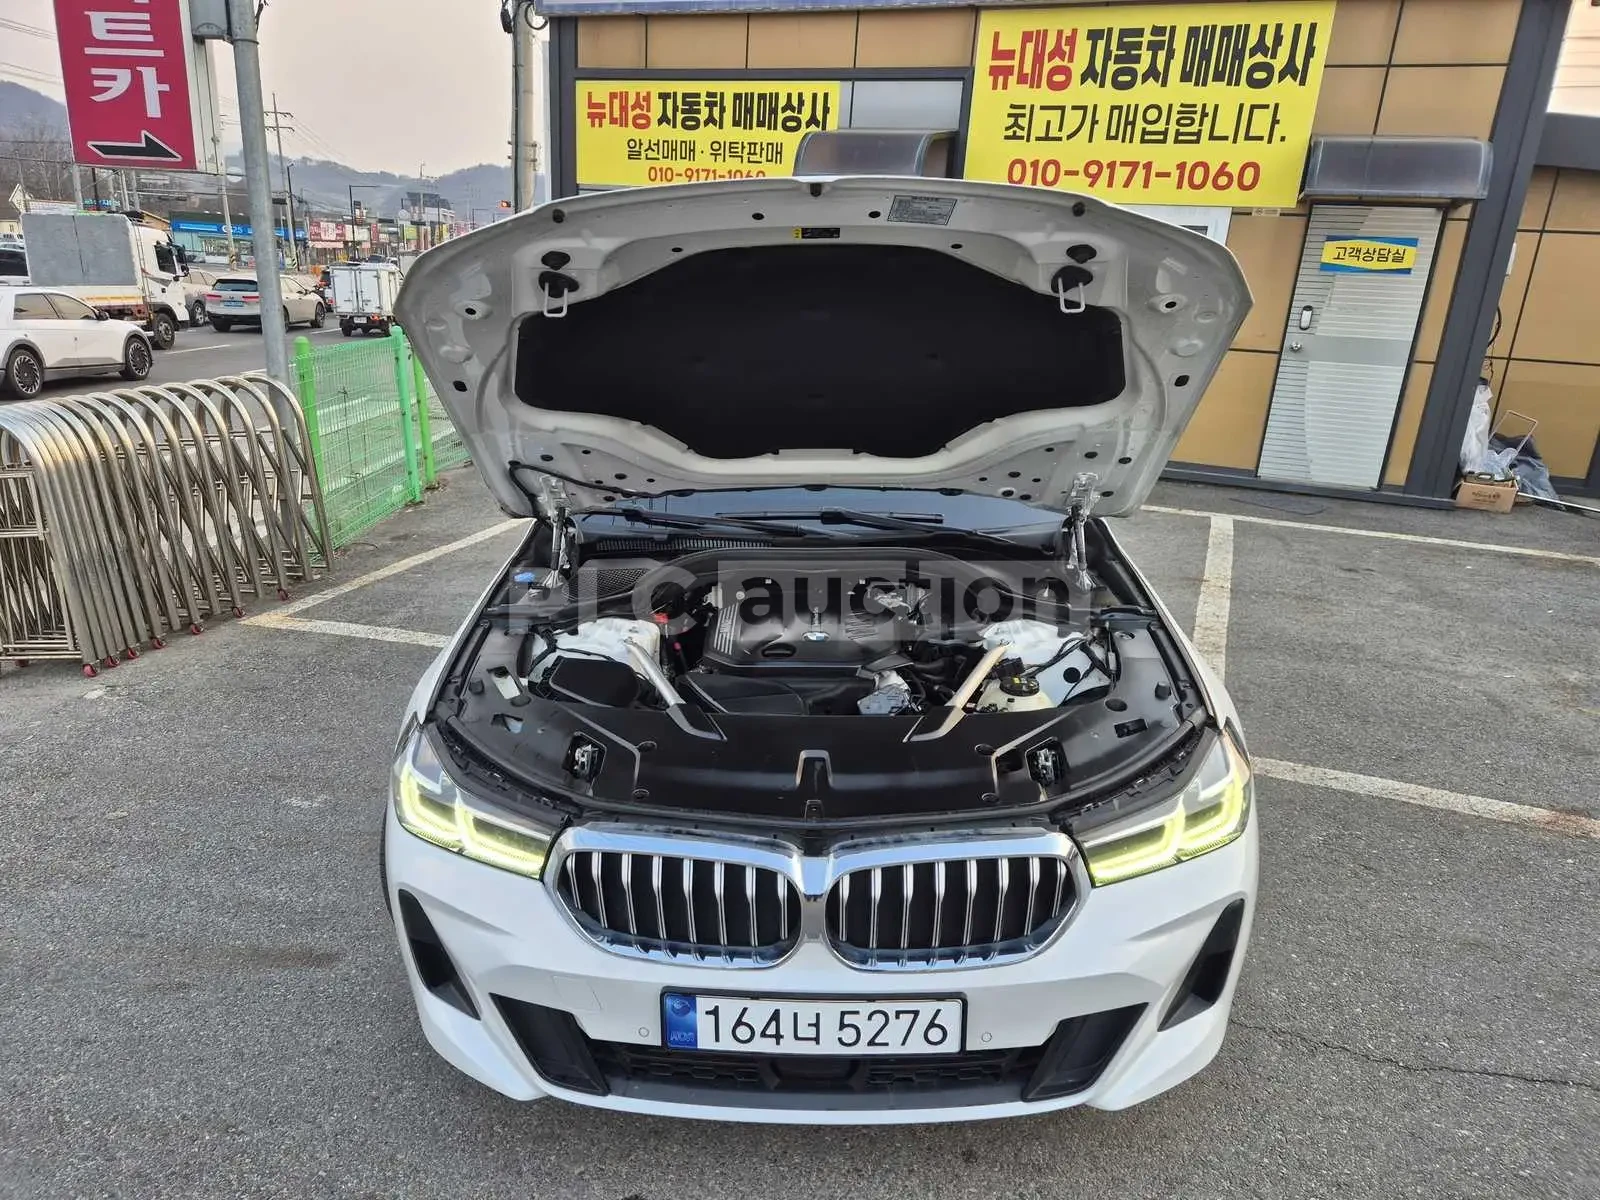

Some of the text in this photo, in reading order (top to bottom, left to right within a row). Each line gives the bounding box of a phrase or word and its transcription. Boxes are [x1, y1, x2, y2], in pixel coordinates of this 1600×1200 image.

[84, 0, 170, 118] 트카
[989, 22, 1318, 91] 뉴대성 자동차 매매상사
[587, 91, 830, 133] 뉴대성 자동차 매매상사
[1003, 102, 1286, 145] 최고가 매입합니다.
[1007, 158, 1261, 192] 010-9171-1060
[1332, 246, 1406, 263] 고객상담실
[704, 1004, 949, 1048] 164너 5276
